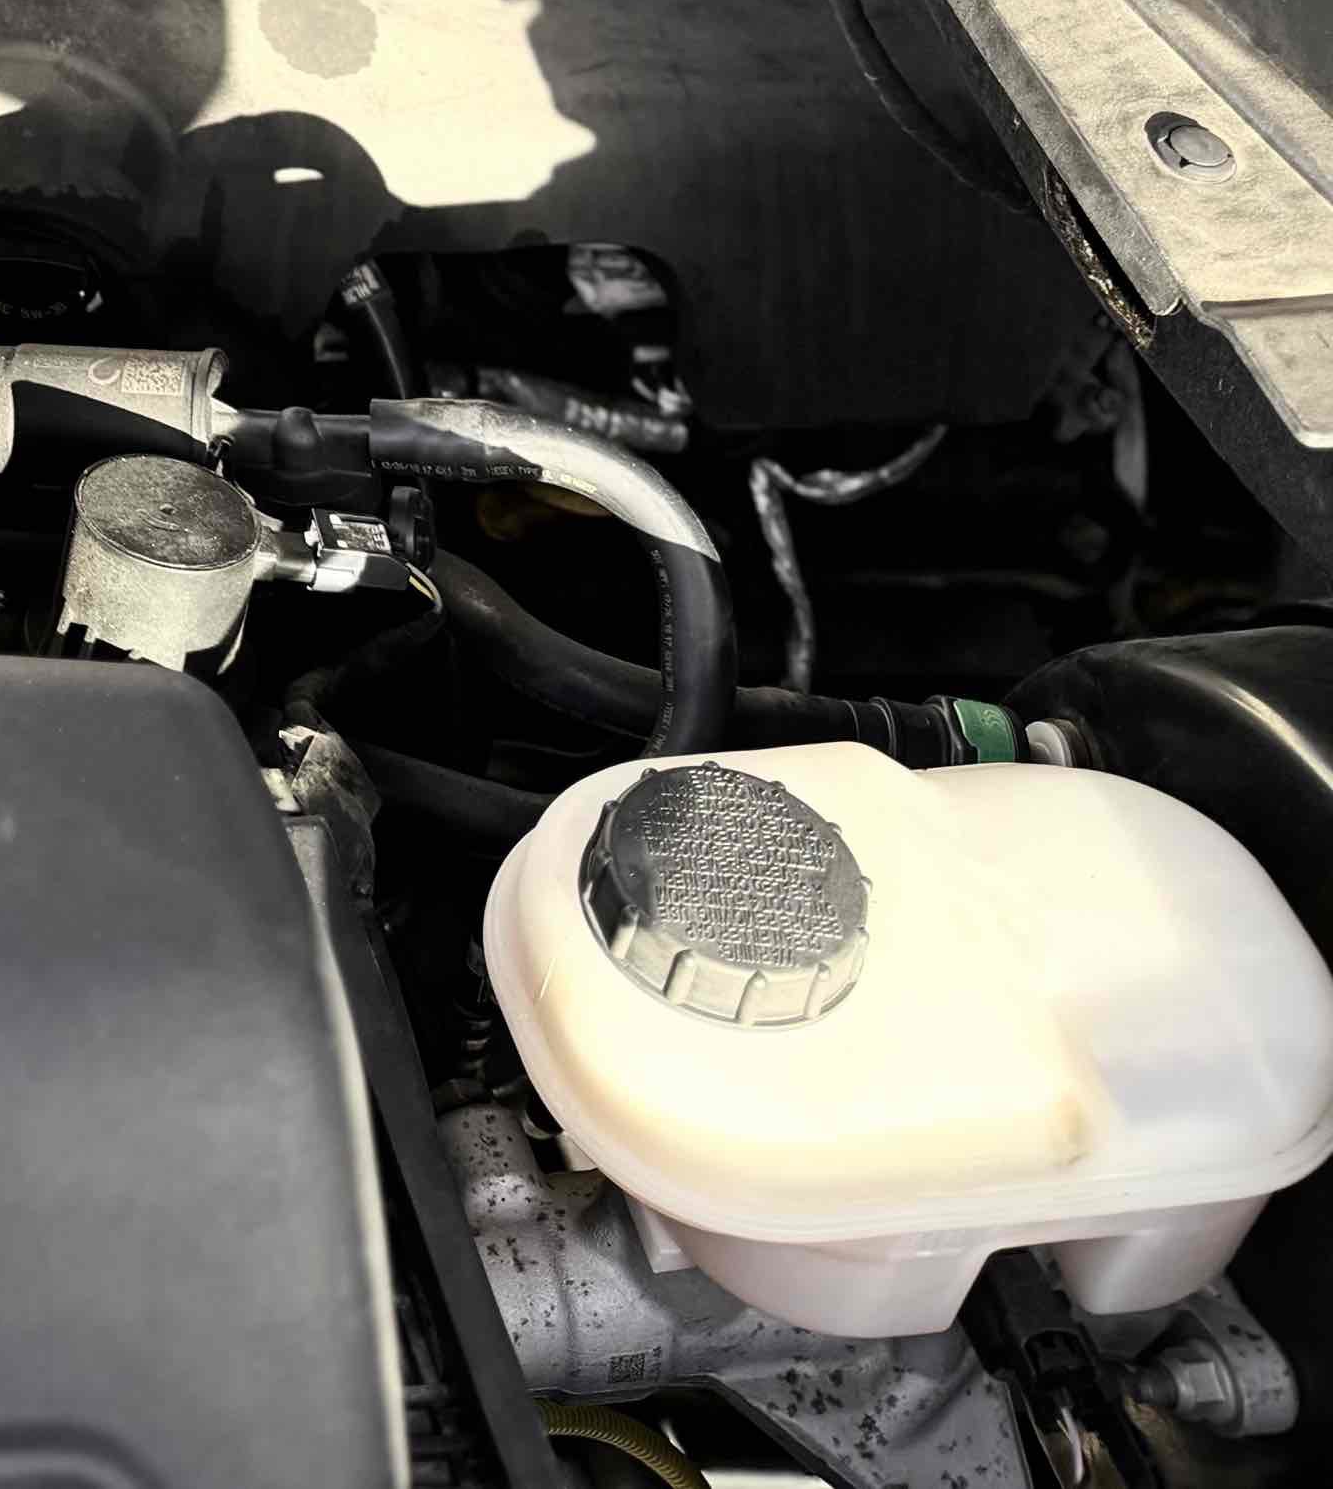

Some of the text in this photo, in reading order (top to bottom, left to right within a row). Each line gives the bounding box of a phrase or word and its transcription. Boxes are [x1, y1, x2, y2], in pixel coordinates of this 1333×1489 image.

[652, 884, 706, 908] FROM
[758, 896, 797, 917] DOT
[655, 904, 693, 925] USE
[794, 899, 840, 921] ONLY
[682, 922, 822, 952] CLEAN FILLER CAP
[778, 915, 845, 939] BEFORE
